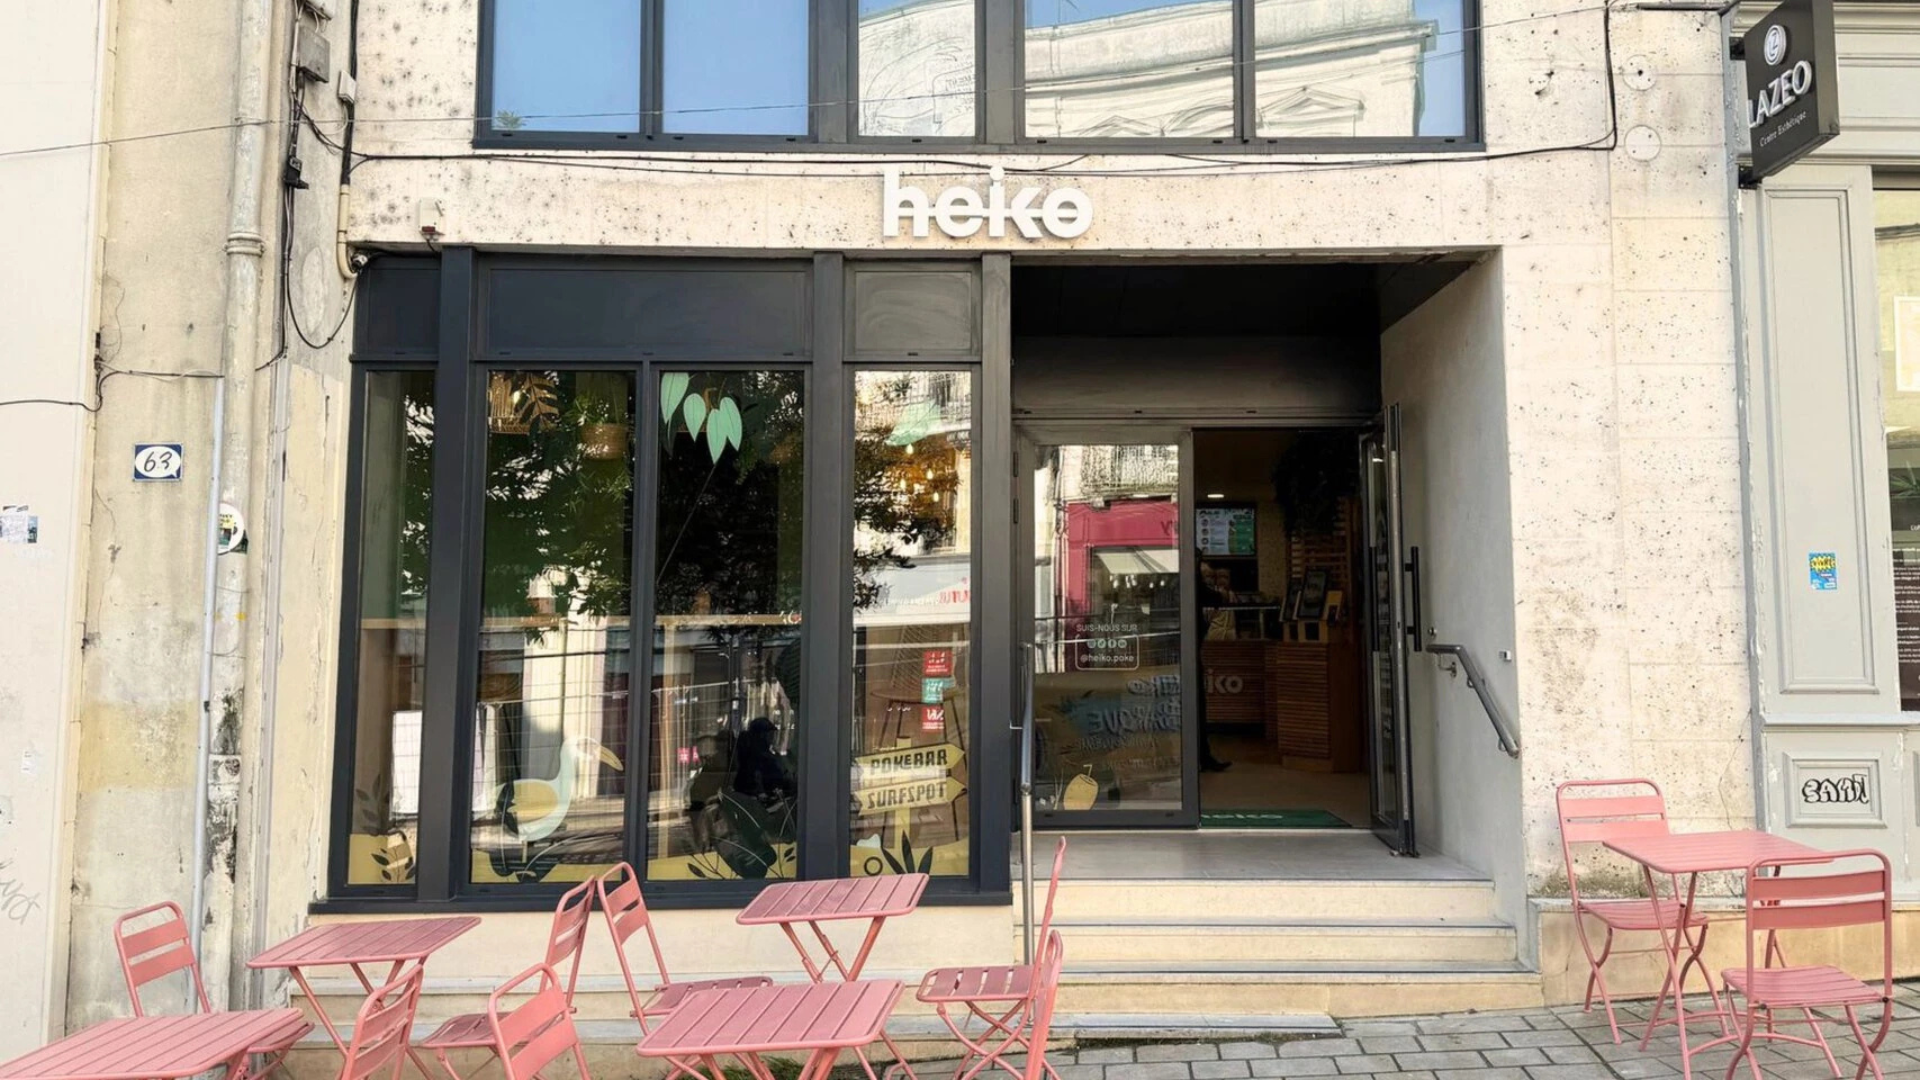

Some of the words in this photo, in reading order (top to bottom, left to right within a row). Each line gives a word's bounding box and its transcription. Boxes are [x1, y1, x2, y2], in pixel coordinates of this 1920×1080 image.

[1747, 61, 1812, 128] LAZEO
[883, 165, 1094, 238] heiko
[143, 451, 172, 472] 63
[1076, 624, 1120, 632] SUIS-NOUS
[1121, 624, 1138, 632] SUR
[1080, 653, 1134, 664] @heiko.poke
[870, 749, 948, 775] POKEBAR
[867, 782, 947, 810] SURFSPOT
